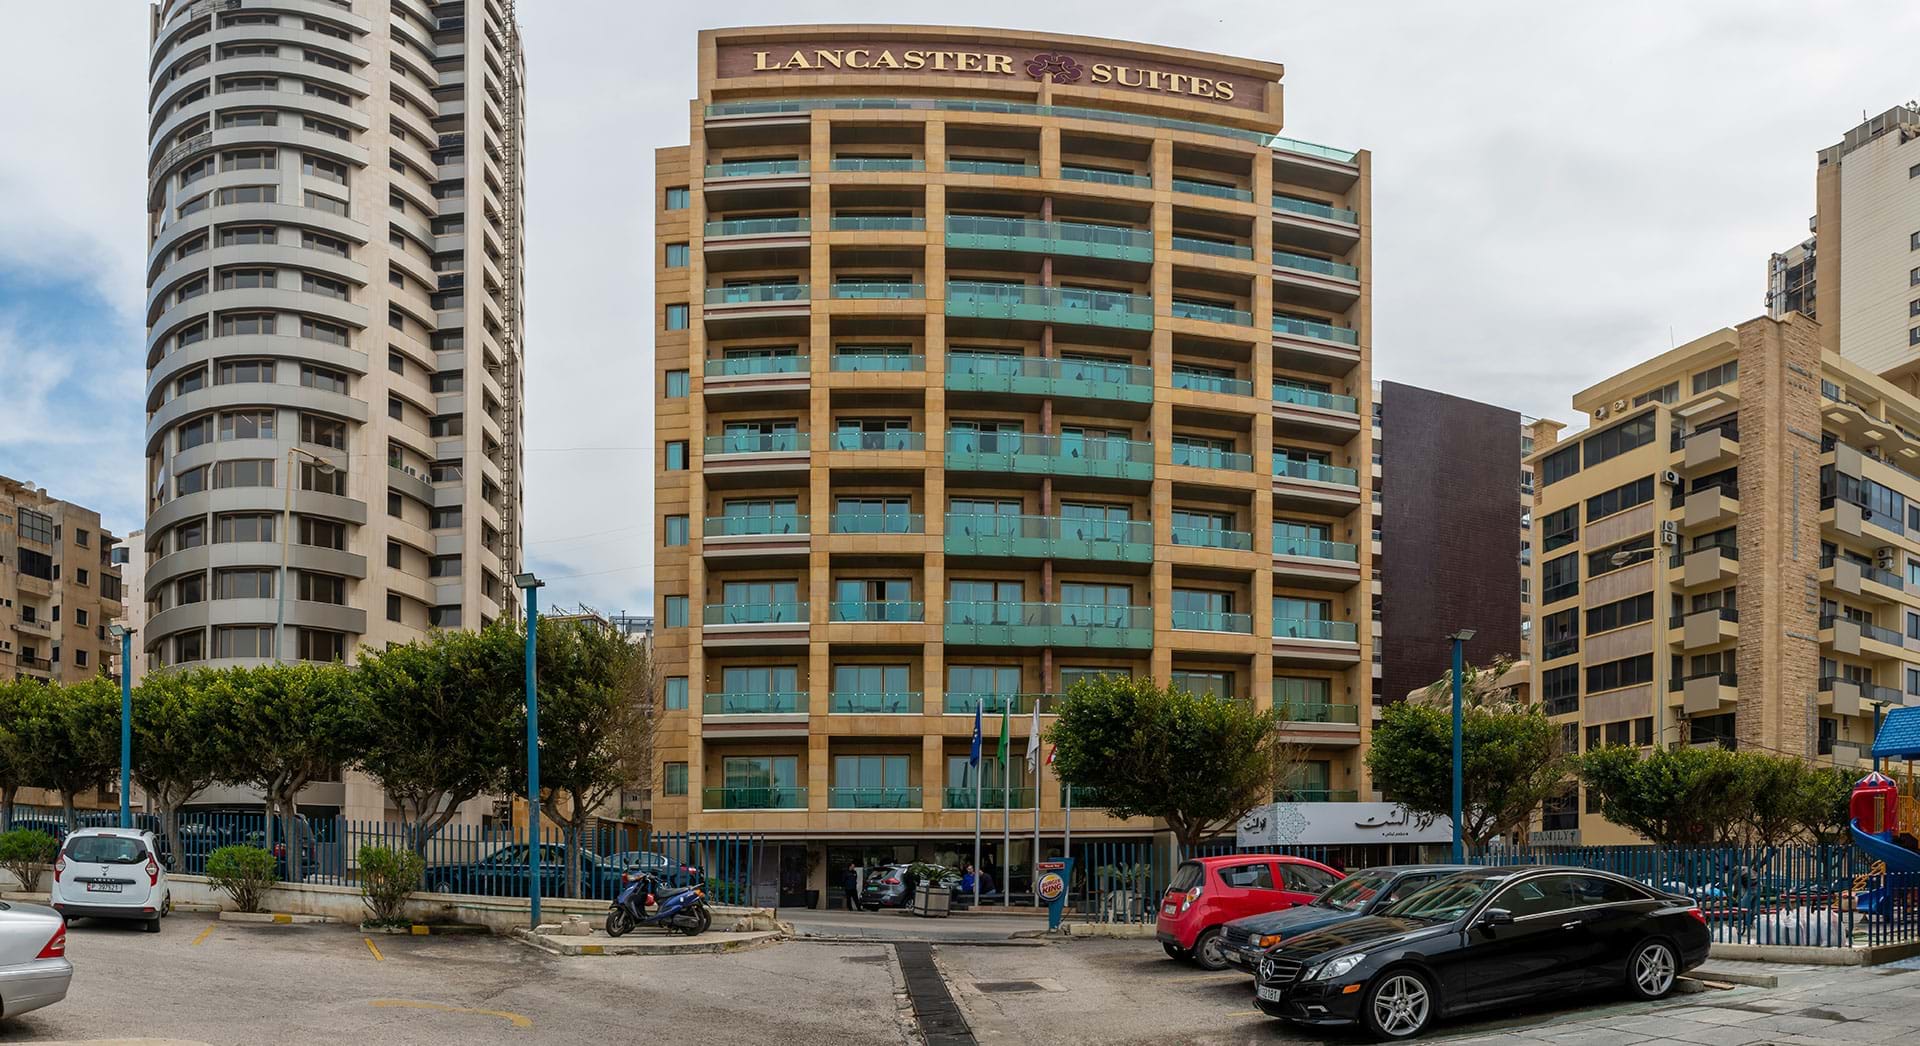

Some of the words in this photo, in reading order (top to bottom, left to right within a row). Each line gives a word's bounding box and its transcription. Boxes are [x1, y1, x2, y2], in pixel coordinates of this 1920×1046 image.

[753, 49, 1016, 74] LANCASTER
[1091, 63, 1234, 100] SUITES
[1533, 831, 1569, 841] FAMILY
[1042, 879, 1061, 888] BURGER
[1042, 883, 1062, 894] KING
